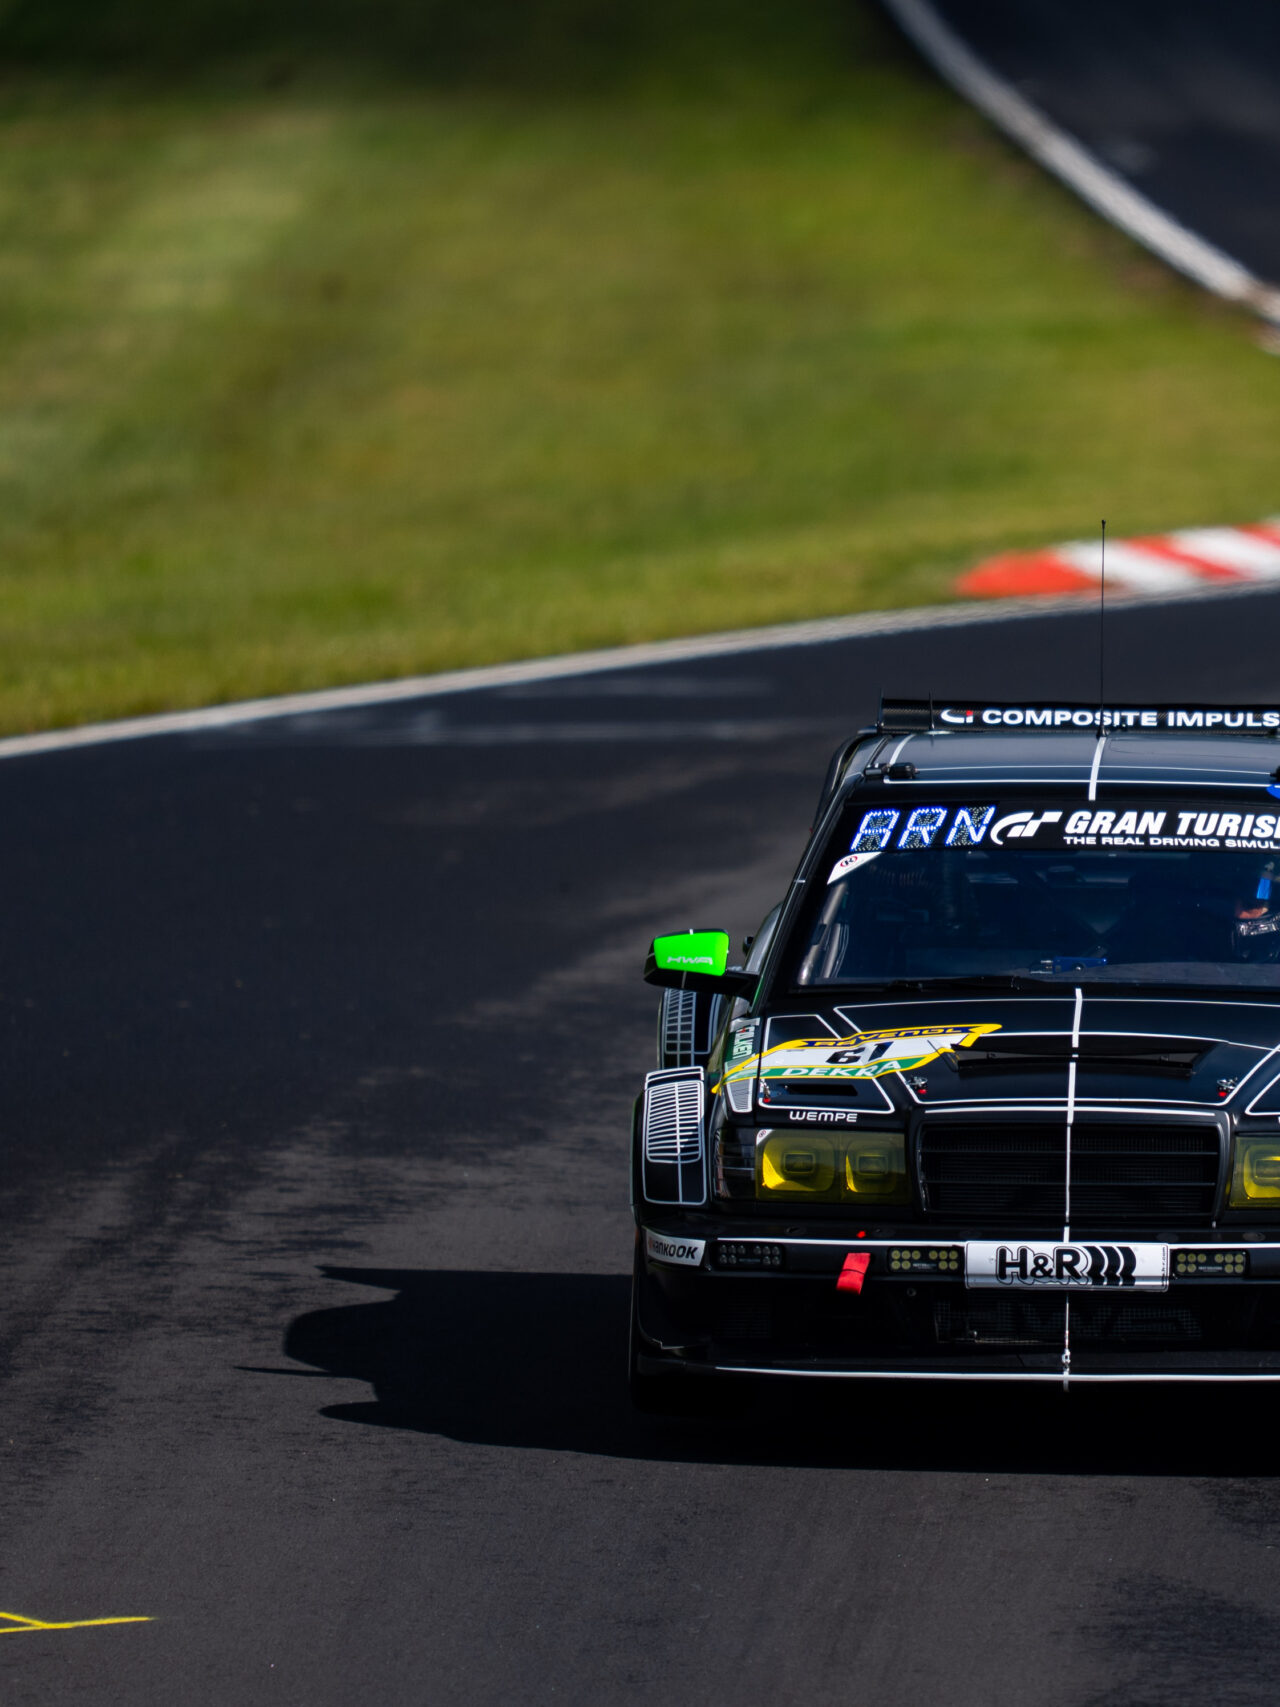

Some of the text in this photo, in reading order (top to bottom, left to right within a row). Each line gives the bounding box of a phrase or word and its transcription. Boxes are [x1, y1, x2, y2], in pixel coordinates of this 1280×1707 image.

[982, 709, 1158, 727] COMPOSITE
[1064, 811, 1167, 835] GRAN
[1063, 836, 1097, 845] THE
[1101, 836, 1145, 846] REAL
[1150, 837, 1220, 848] DRIVING
[667, 956, 713, 966] HWA
[826, 1041, 894, 1065] 61
[781, 1060, 901, 1078] DEKRA
[789, 1110, 858, 1123] WEMPE
[998, 1246, 1085, 1282] H&R
